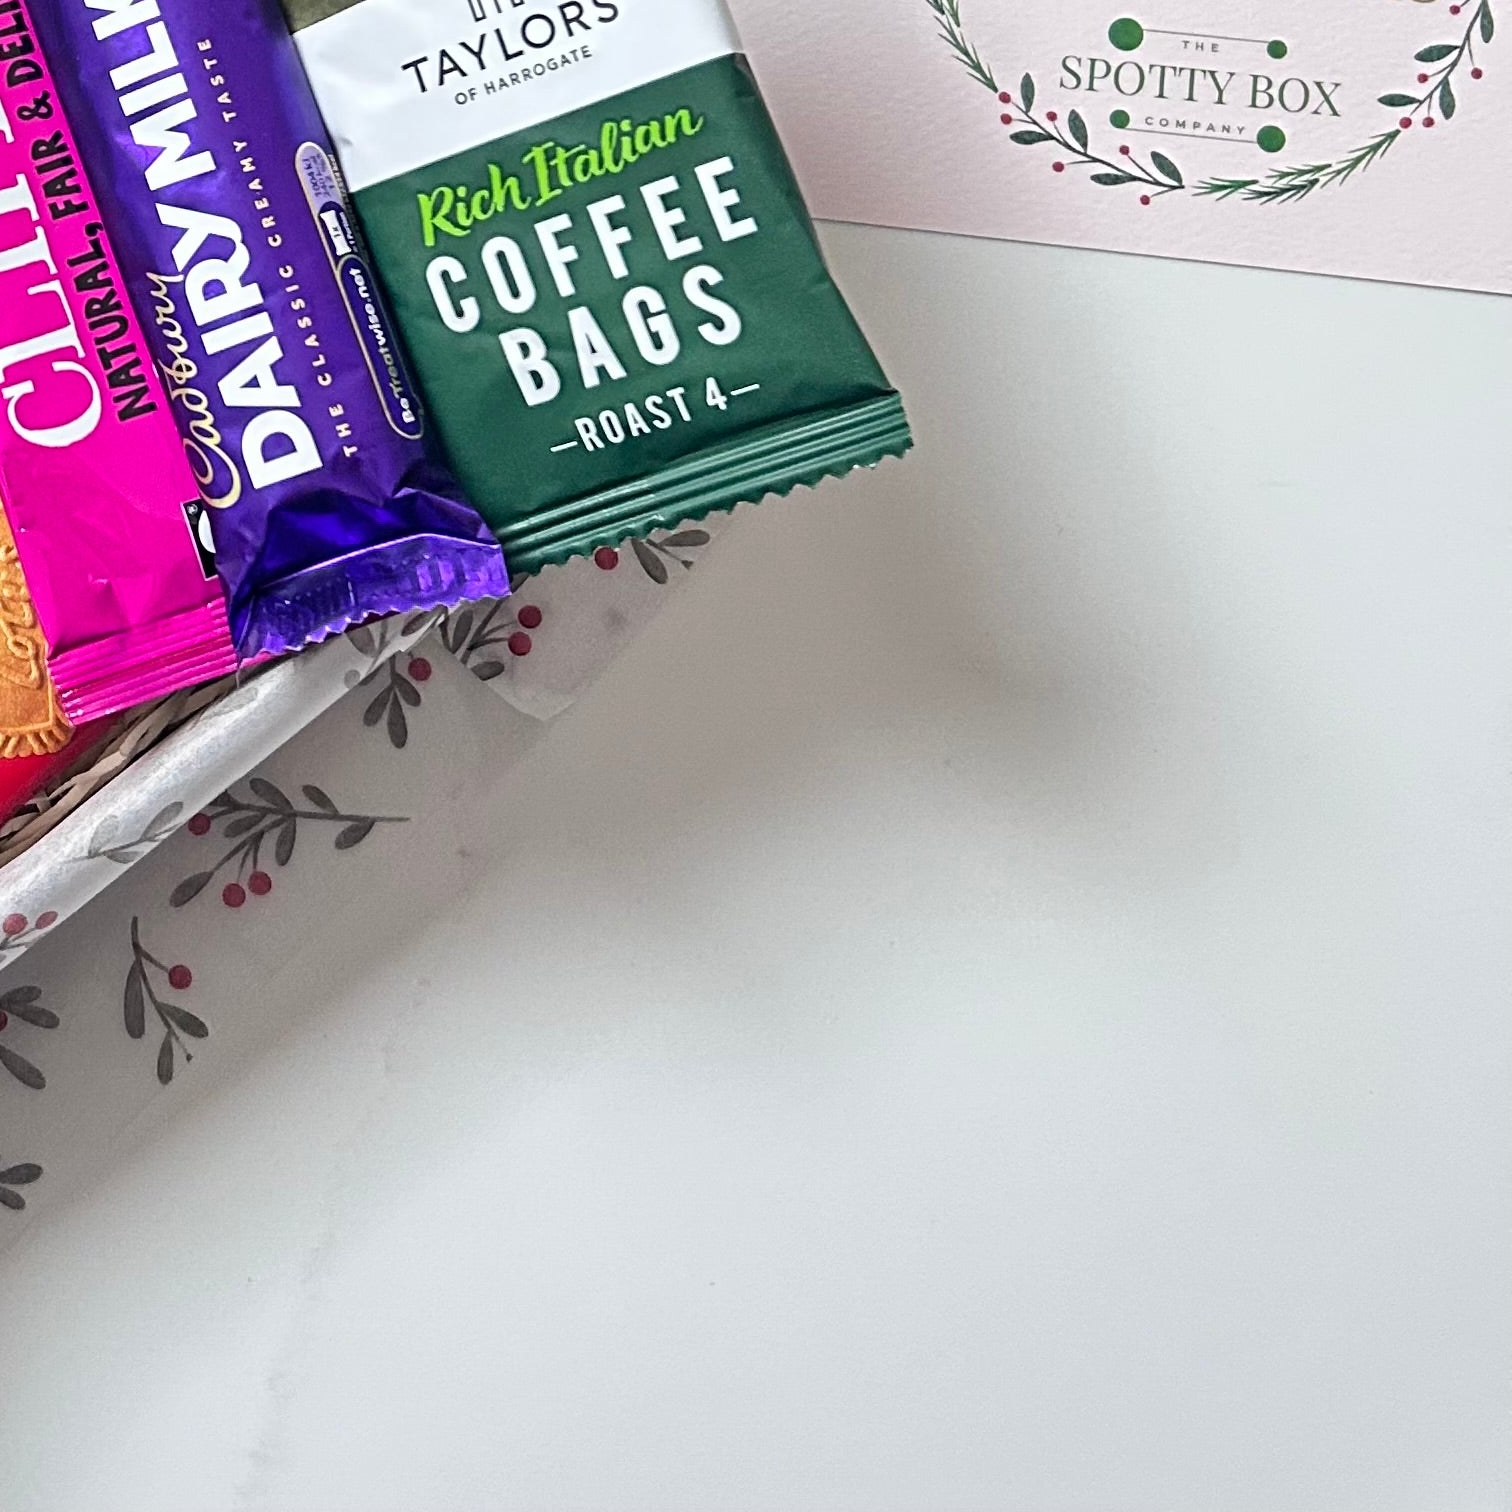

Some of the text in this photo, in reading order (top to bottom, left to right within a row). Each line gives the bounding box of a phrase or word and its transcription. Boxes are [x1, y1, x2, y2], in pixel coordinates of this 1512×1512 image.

[17, 90, 53, 122] &
[454, 44, 594, 106] OF HARROGATE
[1059, 54, 1342, 118] SPOTTY BOX
[1181, 39, 1221, 54] THE
[31, 130, 89, 221] FAIR
[416, 162, 533, 248] Rich
[522, 107, 705, 208] Italian
[1144, 116, 1248, 136] COMPANY
[197, 39, 358, 459] THE CLASSIC CREAMY TASTE
[424, 154, 759, 335] COFFEE
[64, 222, 157, 423] NATURAL,
[145, 270, 242, 509] Cadbury
[156, 201, 324, 490] DAIRY
[497, 263, 744, 408] BAGS
